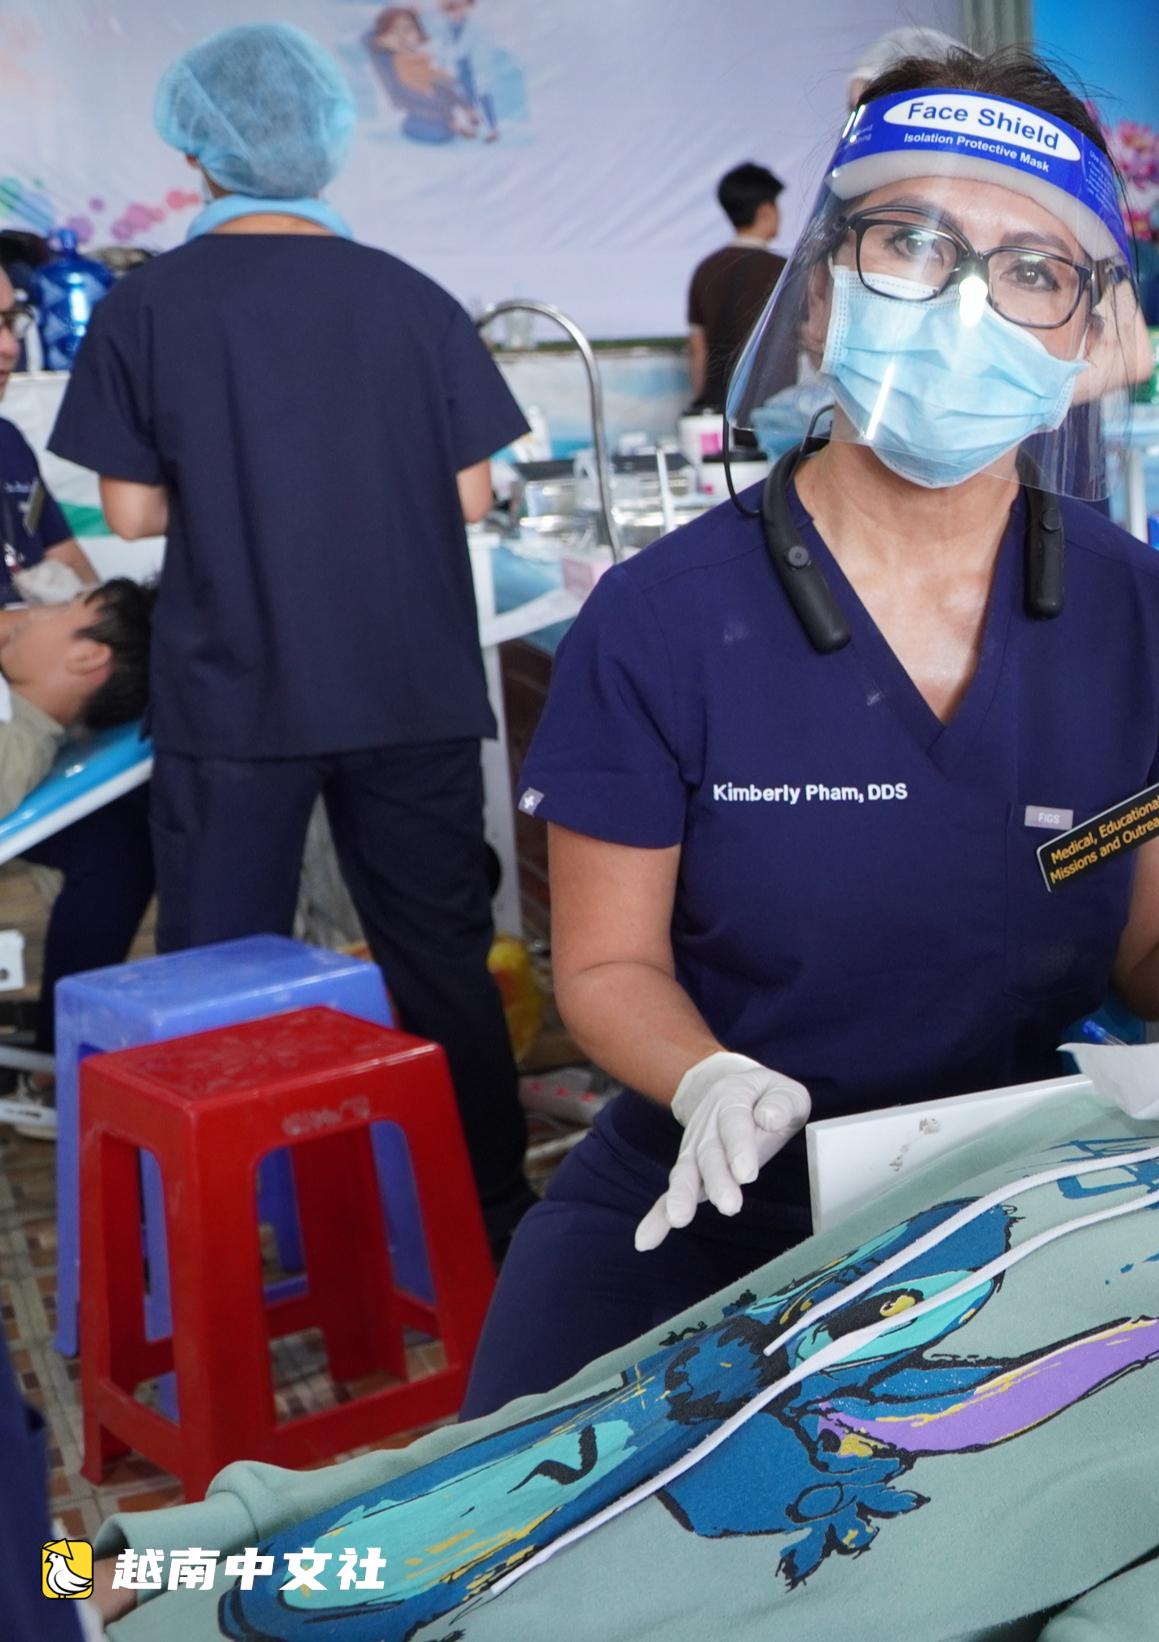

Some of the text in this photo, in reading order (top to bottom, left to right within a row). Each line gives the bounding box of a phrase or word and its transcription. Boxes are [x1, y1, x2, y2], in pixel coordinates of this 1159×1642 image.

[907, 102, 1059, 150] Face Shield
[904, 132, 1050, 172] Isolation Protective Mask
[713, 783, 908, 804] Kimberly Pham, DDS
[1038, 812, 1060, 825] FIGS
[1050, 850, 1098, 884] Missions
[1100, 837, 1121, 857] and
[1051, 832, 1098, 864] Medical,
